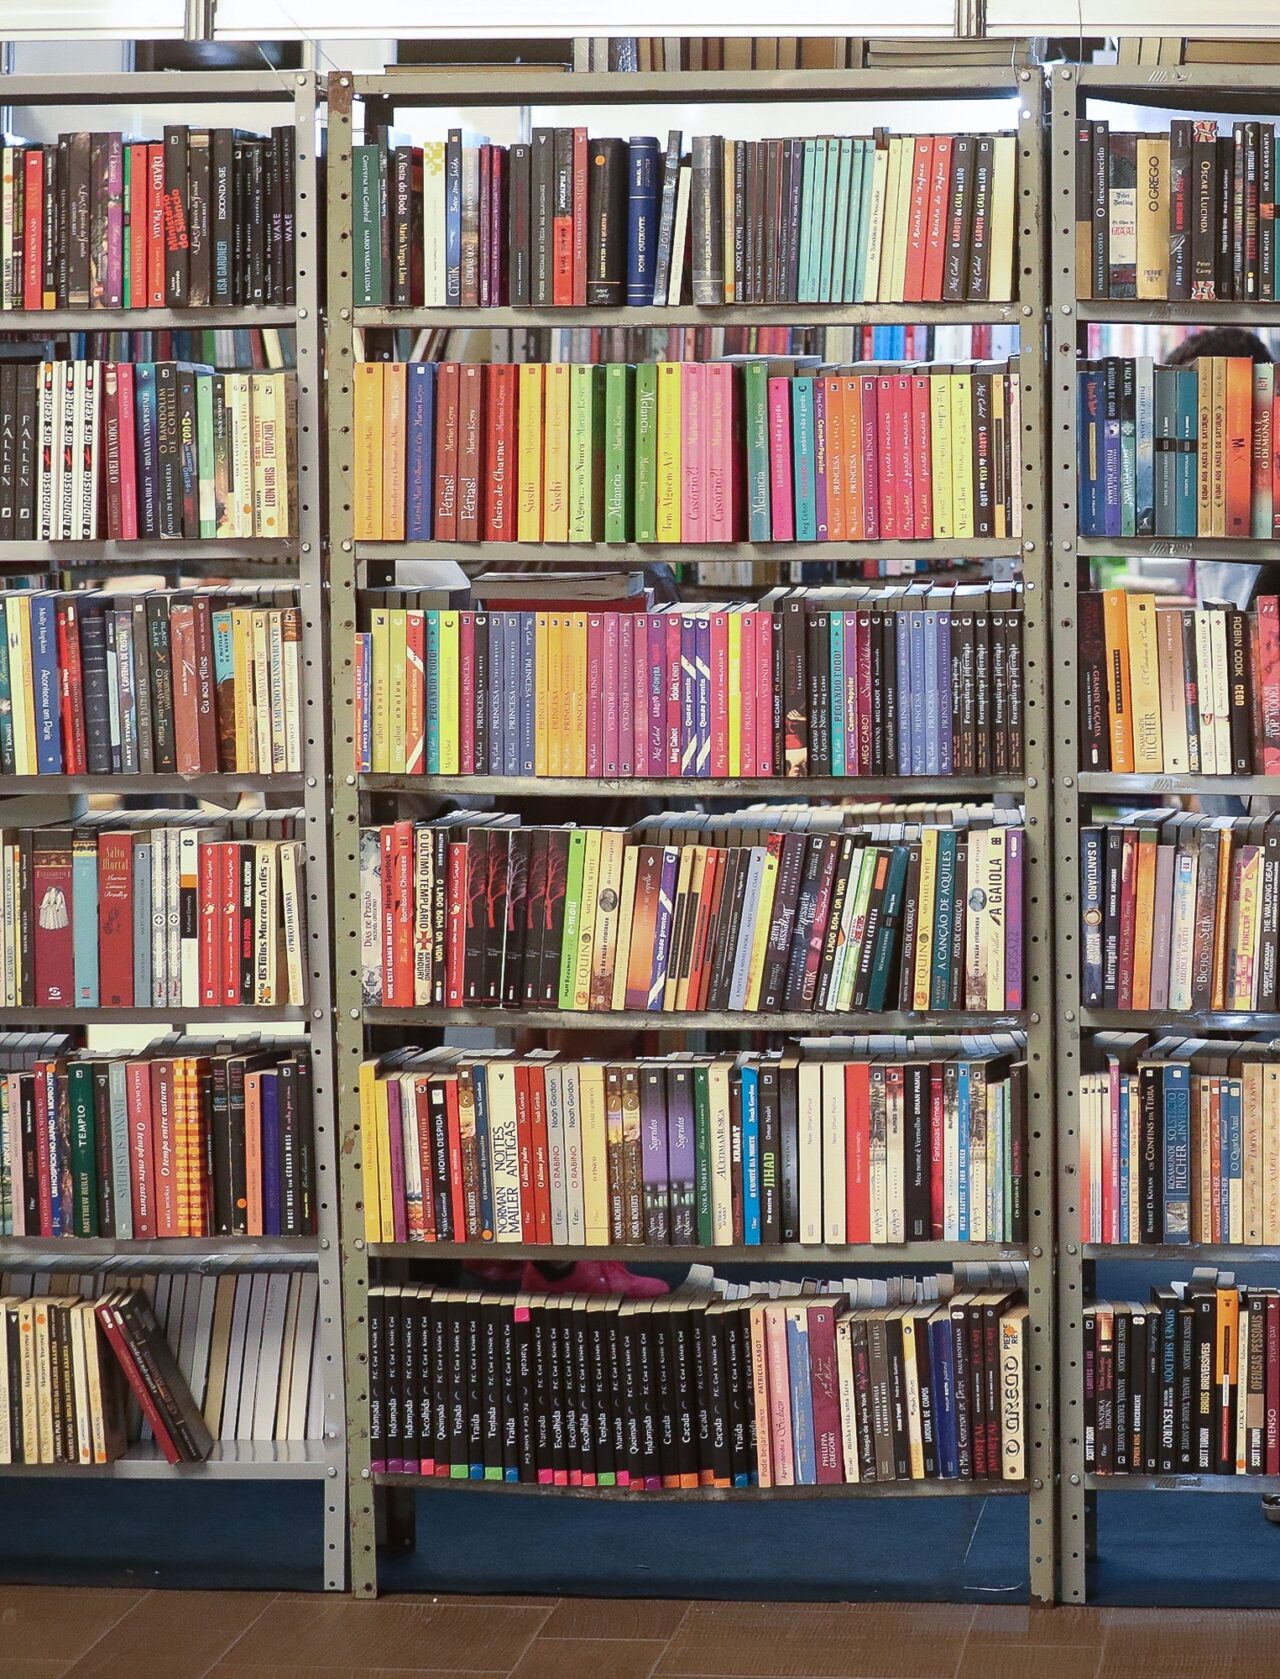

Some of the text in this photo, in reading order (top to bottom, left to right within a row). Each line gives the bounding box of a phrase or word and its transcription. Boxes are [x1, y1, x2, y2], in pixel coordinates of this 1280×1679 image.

[398, 162, 407, 180] festa
[398, 183, 407, 192] do
[956, 168, 964, 183] LADO
[1149, 156, 1159, 212] O GREGO
[173, 189, 188, 248] do Silêncio
[398, 195, 407, 214] Bode
[954, 193, 963, 207] CASA
[164, 195, 179, 251] Ministério
[217, 167, 227, 294] LISA GARDNER ESCONDA-SE
[273, 214, 281, 241] WAKE
[953, 217, 962, 242] GAROTO
[42, 389, 53, 421] kepler
[159, 388, 168, 453] O BANDOLIM
[167, 388, 176, 453] DE CORELLI
[42, 424, 51, 445] lars
[42, 472, 51, 526] hipnotista
[493, 440, 504, 529] Cheio de Charme
[711, 468, 724, 522] Casório?!
[753, 472, 766, 515] Melancia
[199, 656, 208, 678] Alice
[200, 701, 210, 713] Eu
[476, 690, 484, 728] PRINCESA
[1143, 712, 1157, 760] PILCHER
[939, 850, 951, 896] AQUILES
[988, 858, 1002, 915] A GAIOLA
[939, 899, 948, 911] DE
[1264, 884, 1272, 915] WALKING
[258, 867, 267, 980] Os Tolos Morrem Antes
[936, 914, 950, 960] CANÇÃO
[78, 1105, 86, 1147] TEMPLO
[732, 1126, 741, 1162] KRABAT
[494, 1126, 505, 1171] NOITES
[504, 1121, 516, 1177] ANTIGAS
[762, 1152, 774, 1187] JIHAD
[82, 1198, 90, 1233] MATTHEW
[497, 1186, 508, 1234] NORMAN
[508, 1187, 520, 1234] MAILER
[1251, 1315, 1262, 1390] OFENSAS PESSOAIS
[1004, 1356, 1019, 1457] O GREGO
[1199, 1343, 1210, 1467] SCOTT TUROW ERROS IRREVERSÍVEIS
[471, 1414, 480, 1442] Traída
[821, 1432, 829, 1466] PHILIPPA
[1267, 1409, 1276, 1448] INTENSO
[827, 1432, 836, 1468] GREGORY
